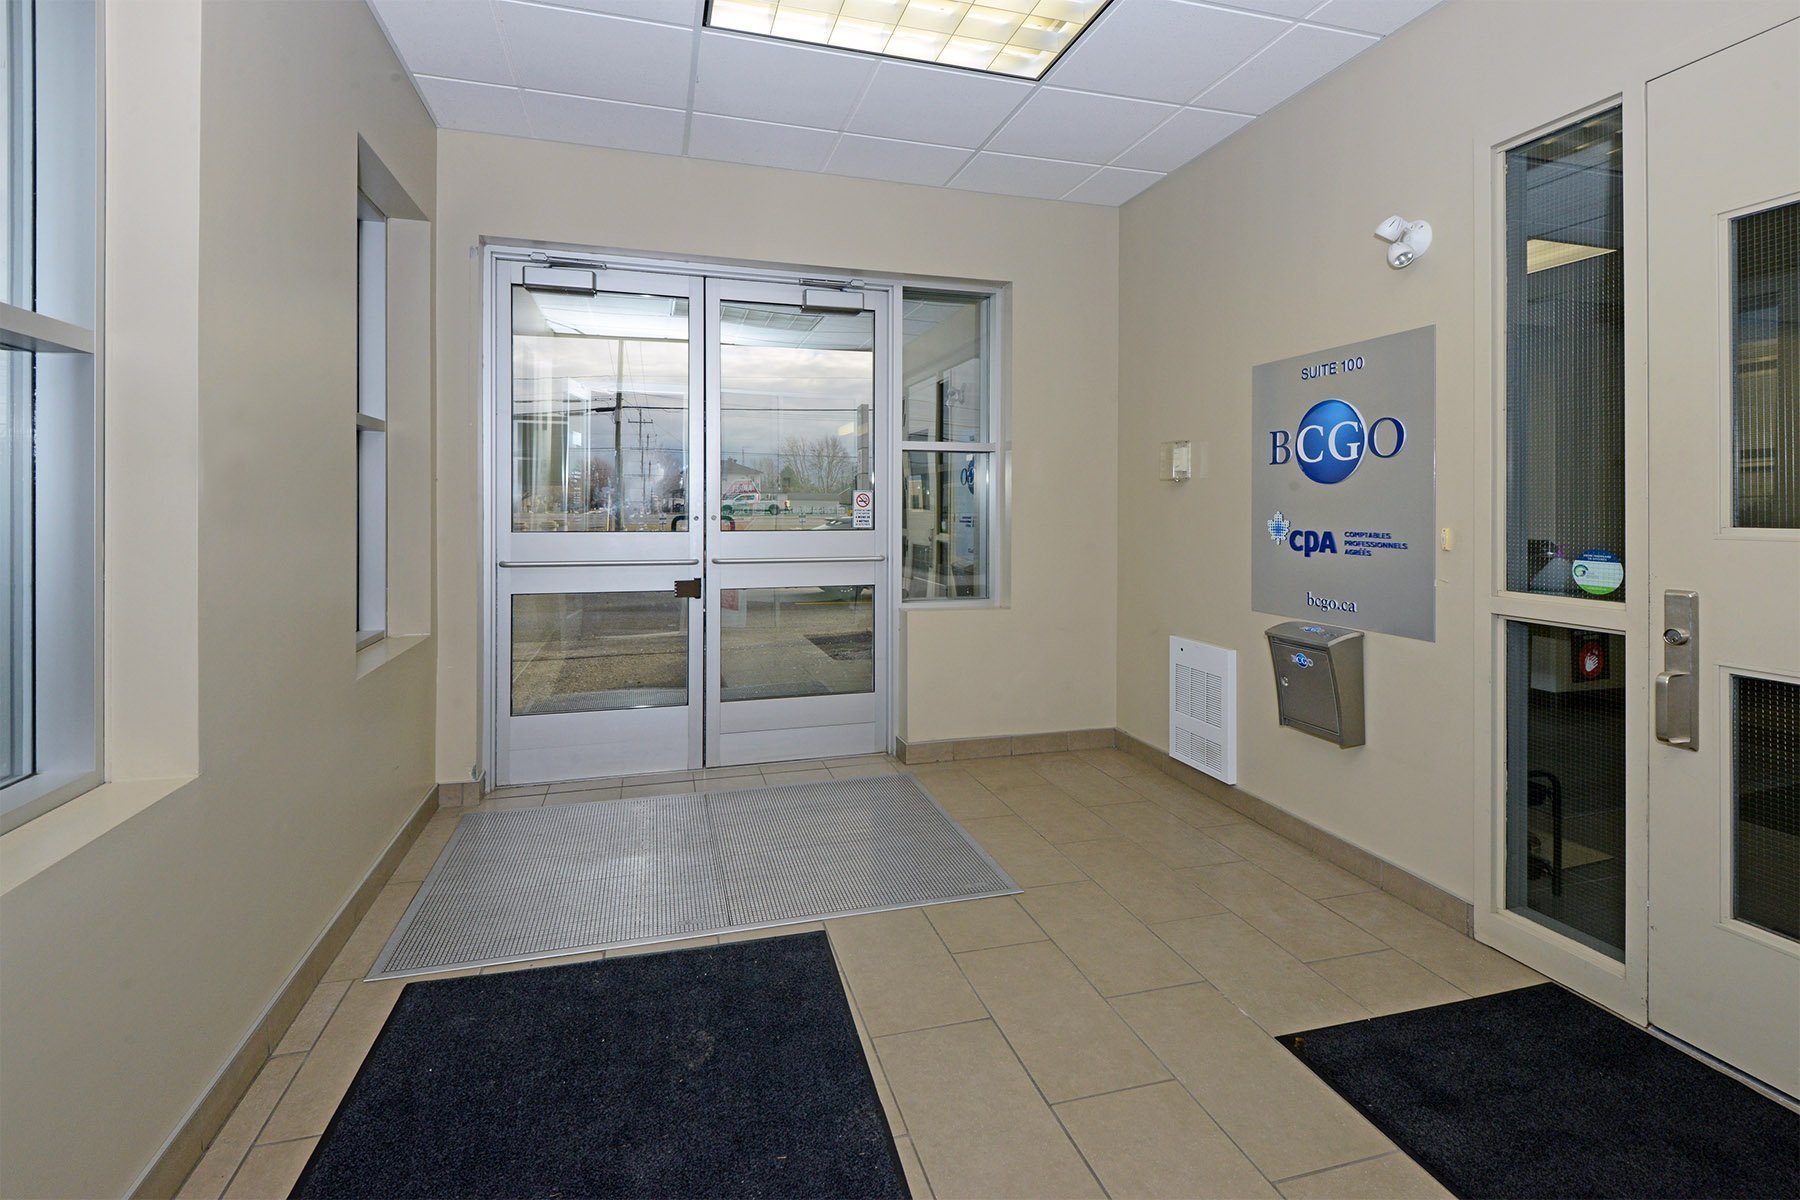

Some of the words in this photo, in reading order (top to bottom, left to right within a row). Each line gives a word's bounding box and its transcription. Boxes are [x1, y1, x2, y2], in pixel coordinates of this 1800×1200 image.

[1301, 362, 1337, 380] SUITE
[1341, 356, 1365, 372] 100
[1269, 417, 1407, 465] BCGO
[1344, 531, 1392, 540] COMPTABLES
[1344, 540, 1409, 550] PROFESSIONNELS
[1344, 548, 1372, 557] AGRÉÉS
[1307, 592, 1357, 613] bcgo.ca
